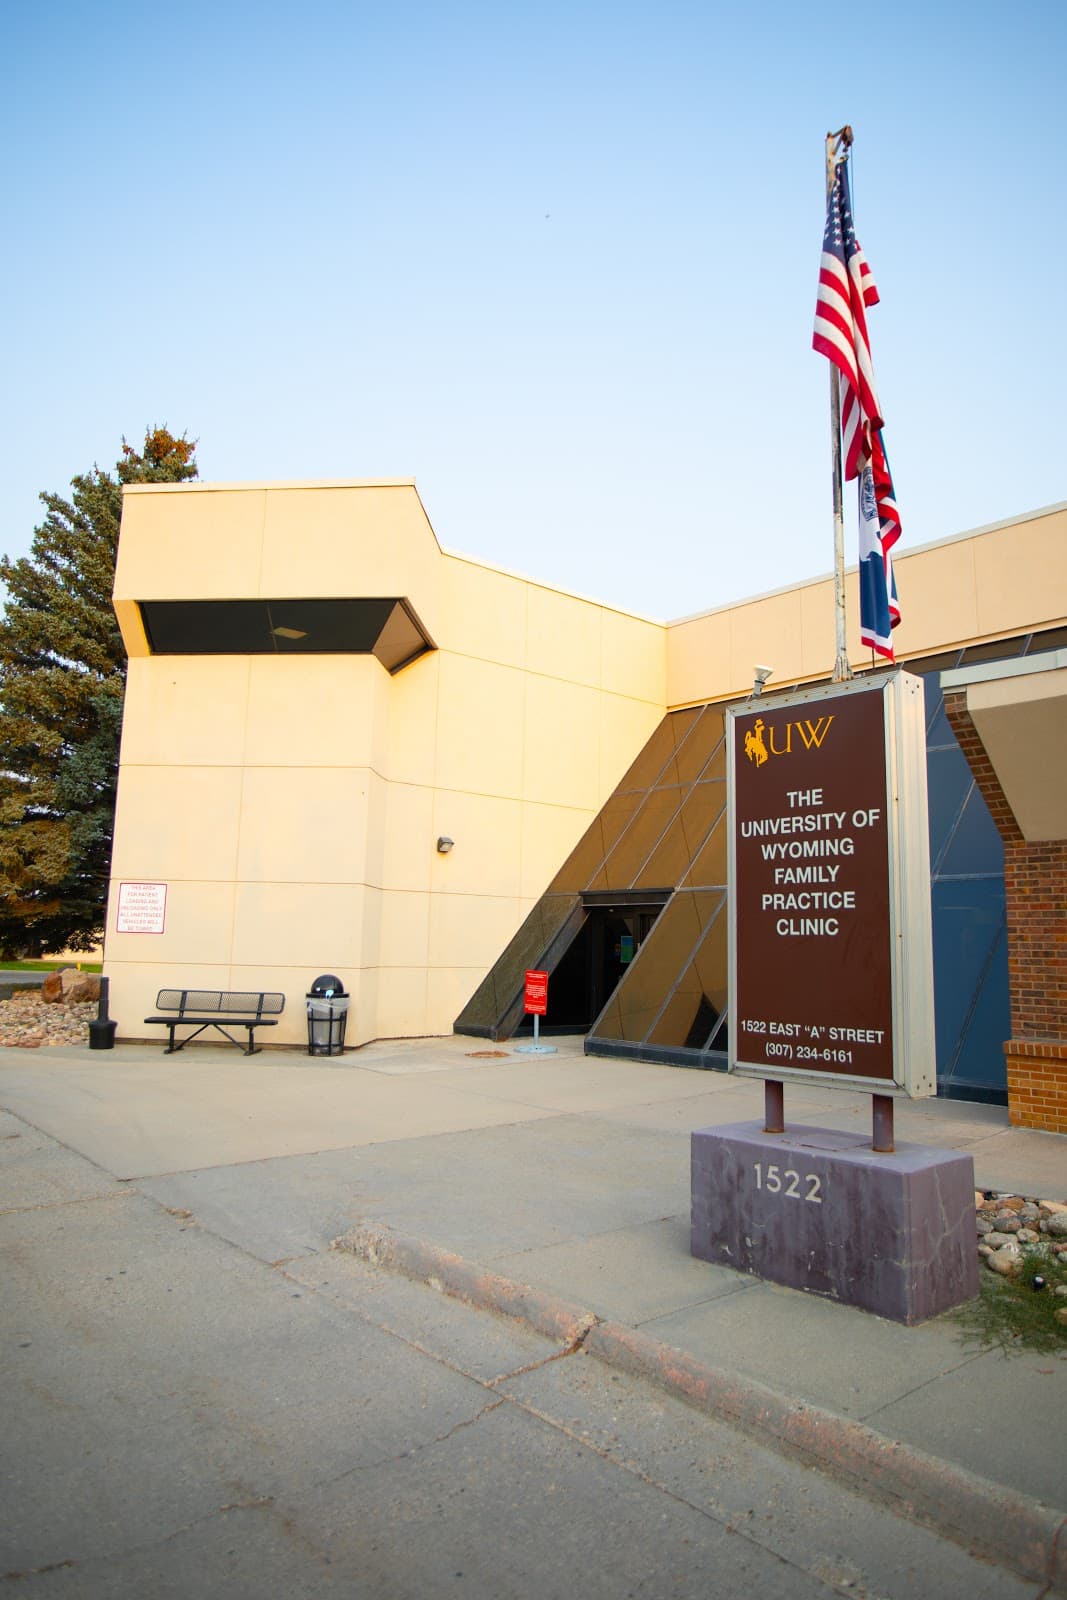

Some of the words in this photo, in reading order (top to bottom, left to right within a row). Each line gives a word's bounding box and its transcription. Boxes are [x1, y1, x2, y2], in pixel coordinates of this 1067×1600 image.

[769, 715, 835, 755] UW
[786, 788, 823, 808] THE
[741, 811, 846, 838] UNIVERSITY
[852, 808, 881, 828] OF
[761, 838, 855, 860] WYOMING
[774, 865, 840, 885] FAMILY
[761, 891, 856, 910] PRACTICE
[776, 918, 839, 936] CLINIC
[741, 1020, 767, 1033] 1522
[769, 1022, 801, 1036] EAST
[829, 1027, 884, 1044] STREET
[765, 1042, 793, 1059] (307)
[796, 1046, 853, 1063] 234-6161
[753, 1162, 822, 1203] 1522
